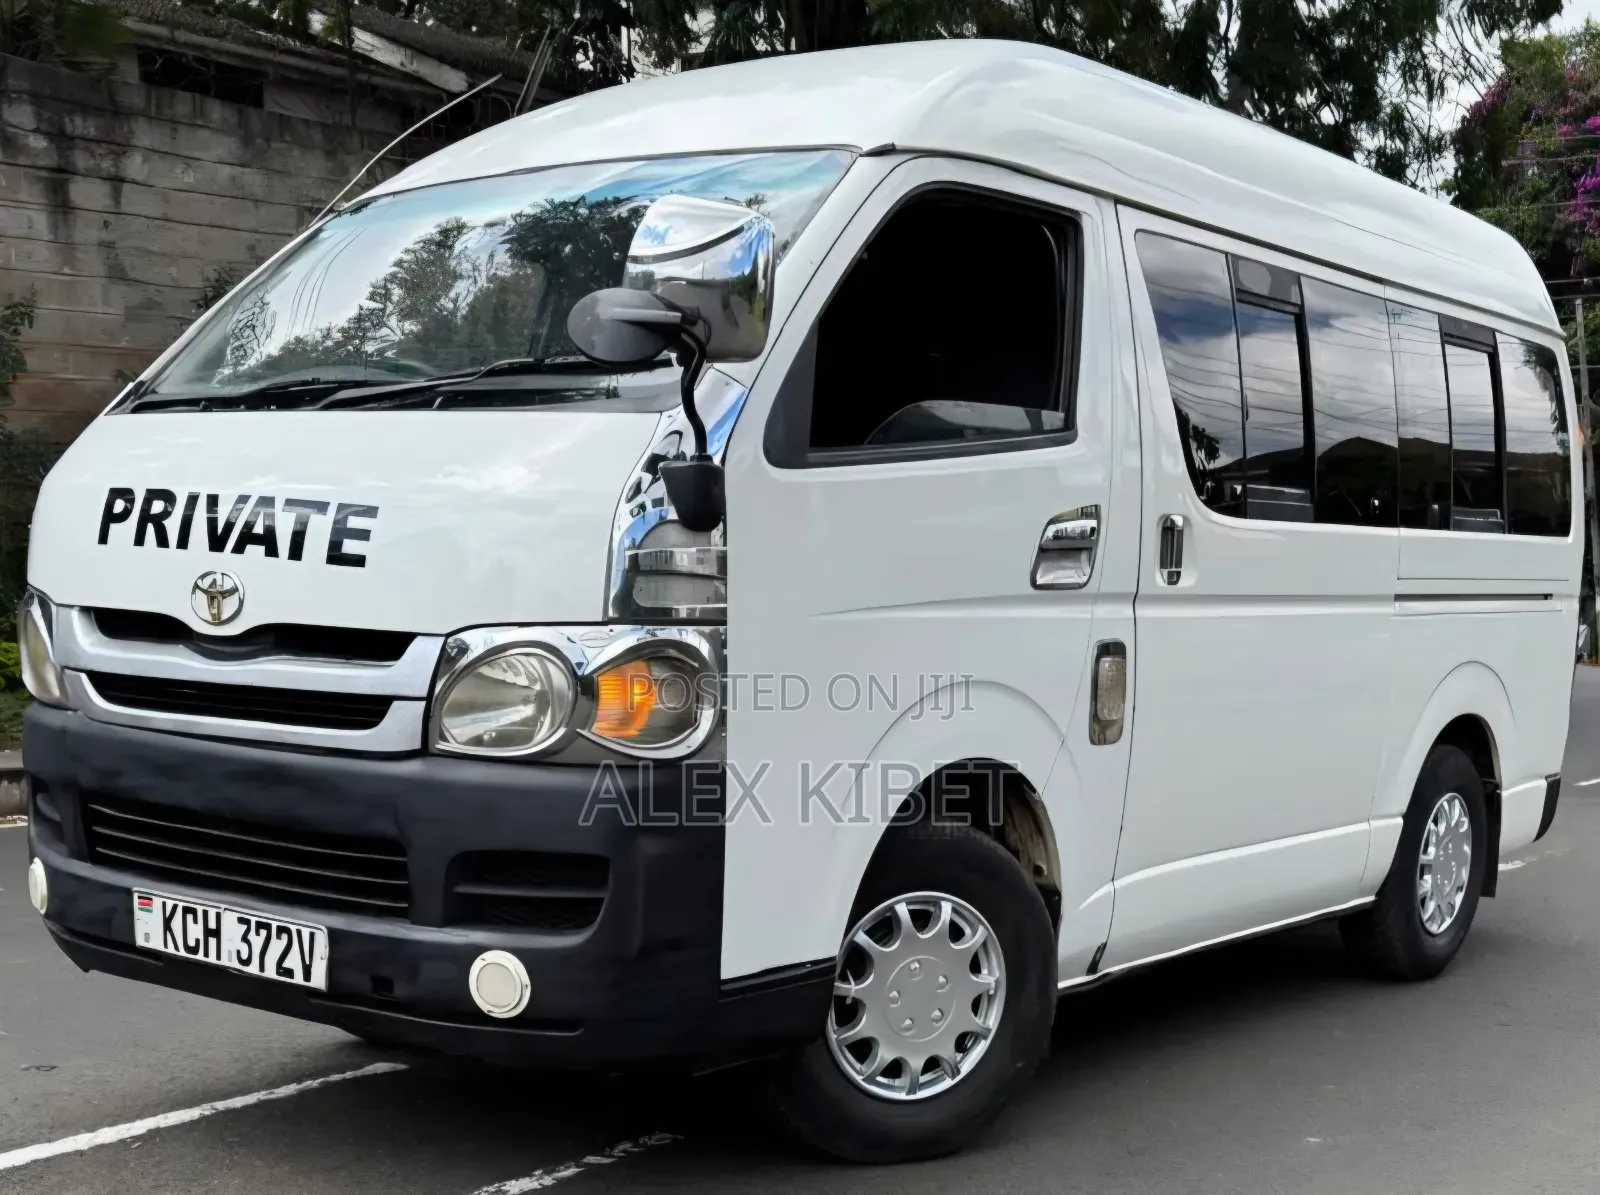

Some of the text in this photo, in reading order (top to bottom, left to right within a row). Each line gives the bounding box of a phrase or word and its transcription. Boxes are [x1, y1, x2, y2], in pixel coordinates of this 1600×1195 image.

[97, 487, 379, 568] PRIVATE
[161, 900, 315, 983] KCH 372V
